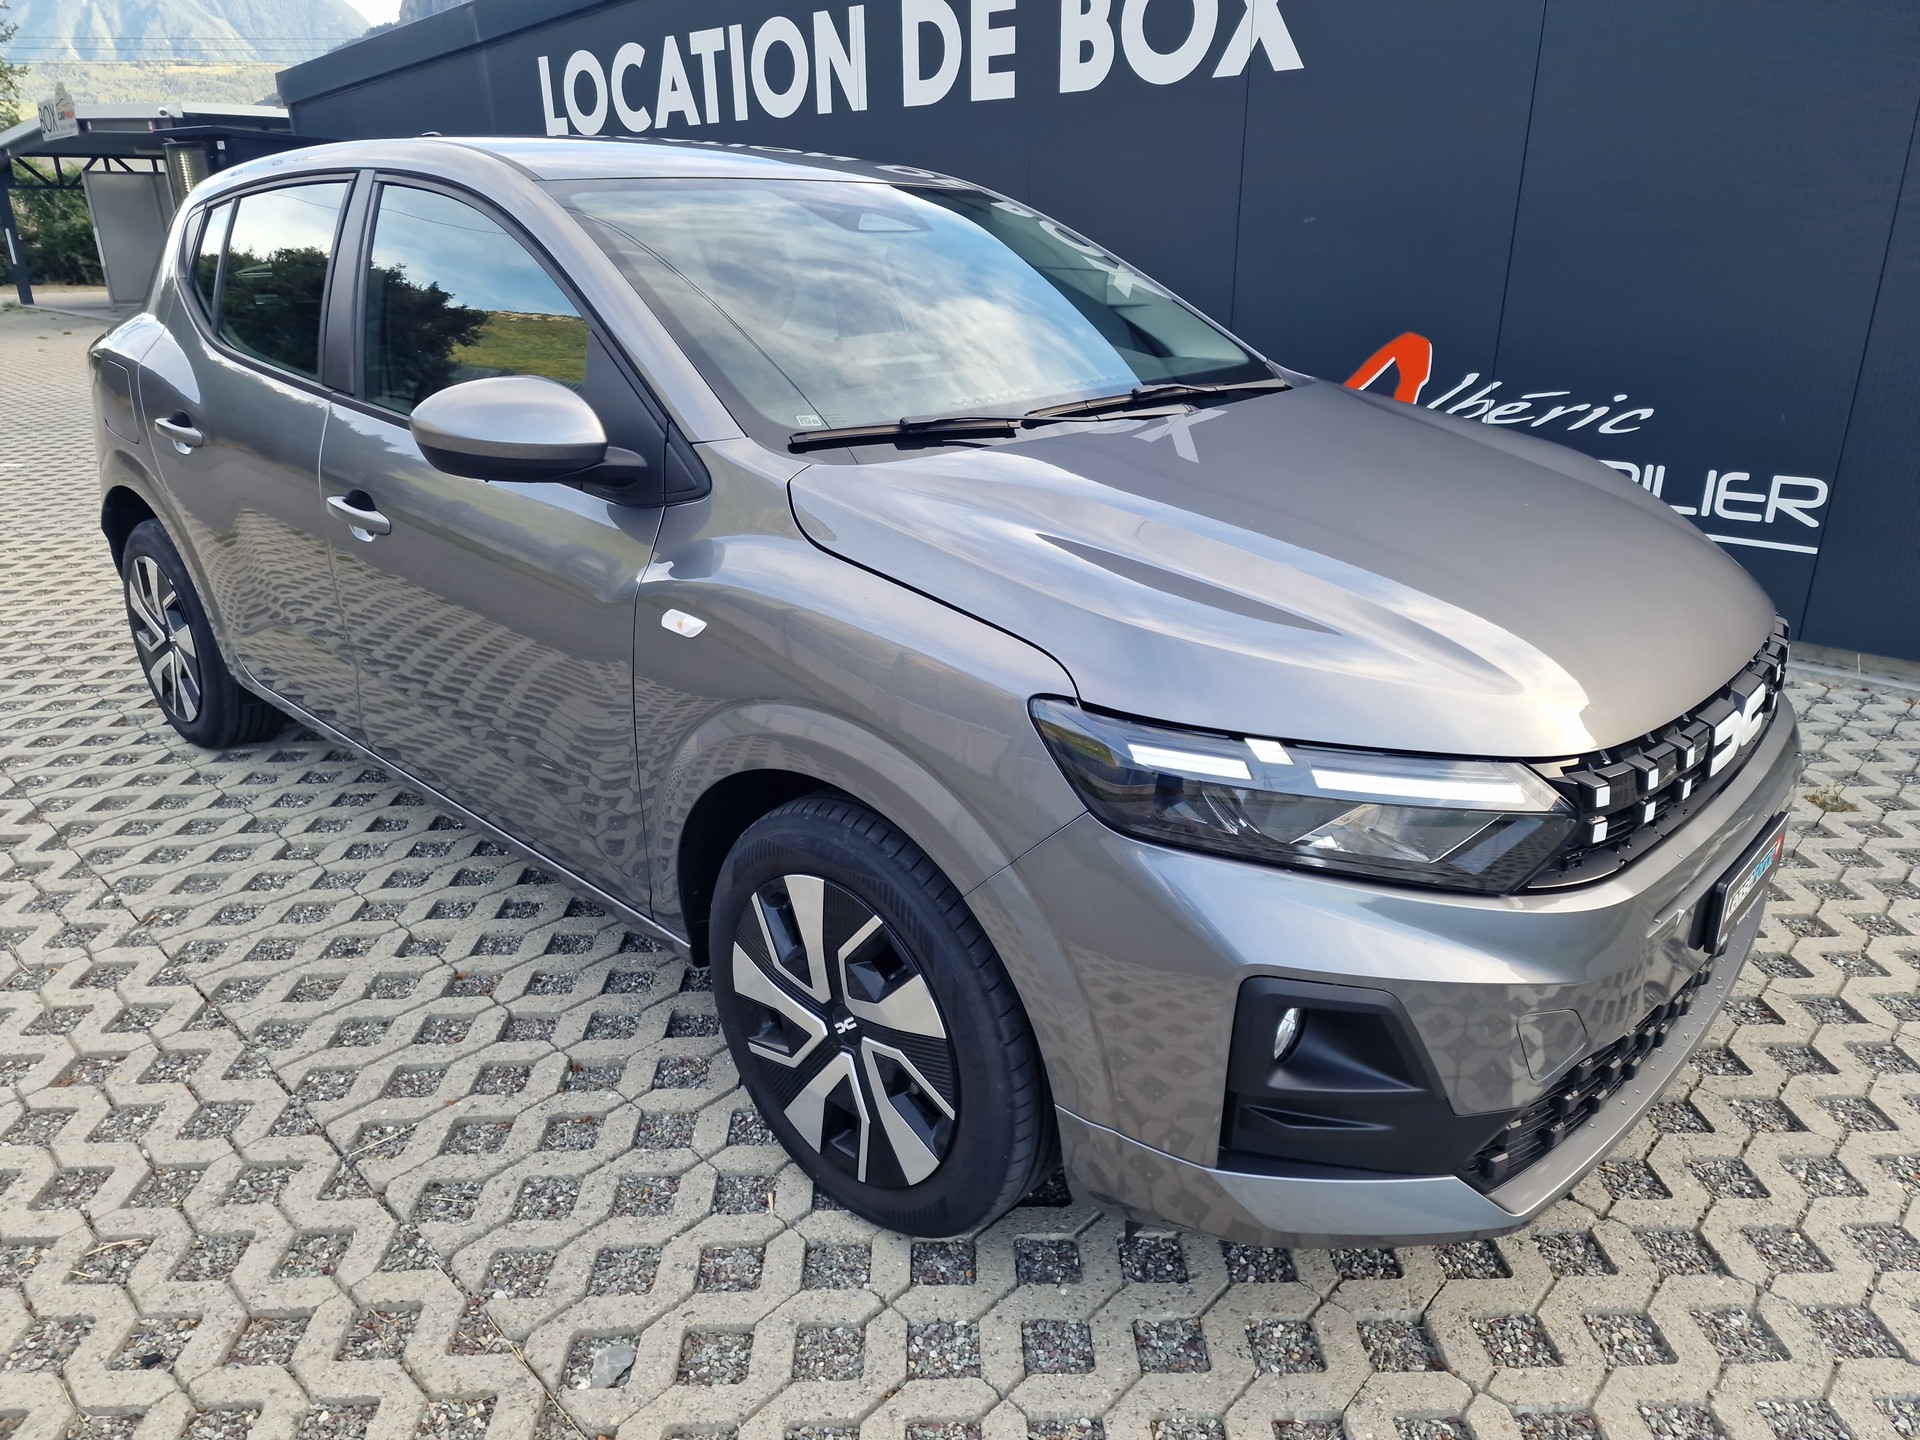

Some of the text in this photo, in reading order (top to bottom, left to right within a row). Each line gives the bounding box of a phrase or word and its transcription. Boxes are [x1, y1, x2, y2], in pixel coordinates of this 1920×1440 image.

[538, 0, 1305, 136] LOCATION DE BOX
[38, 103, 59, 134] BOX
